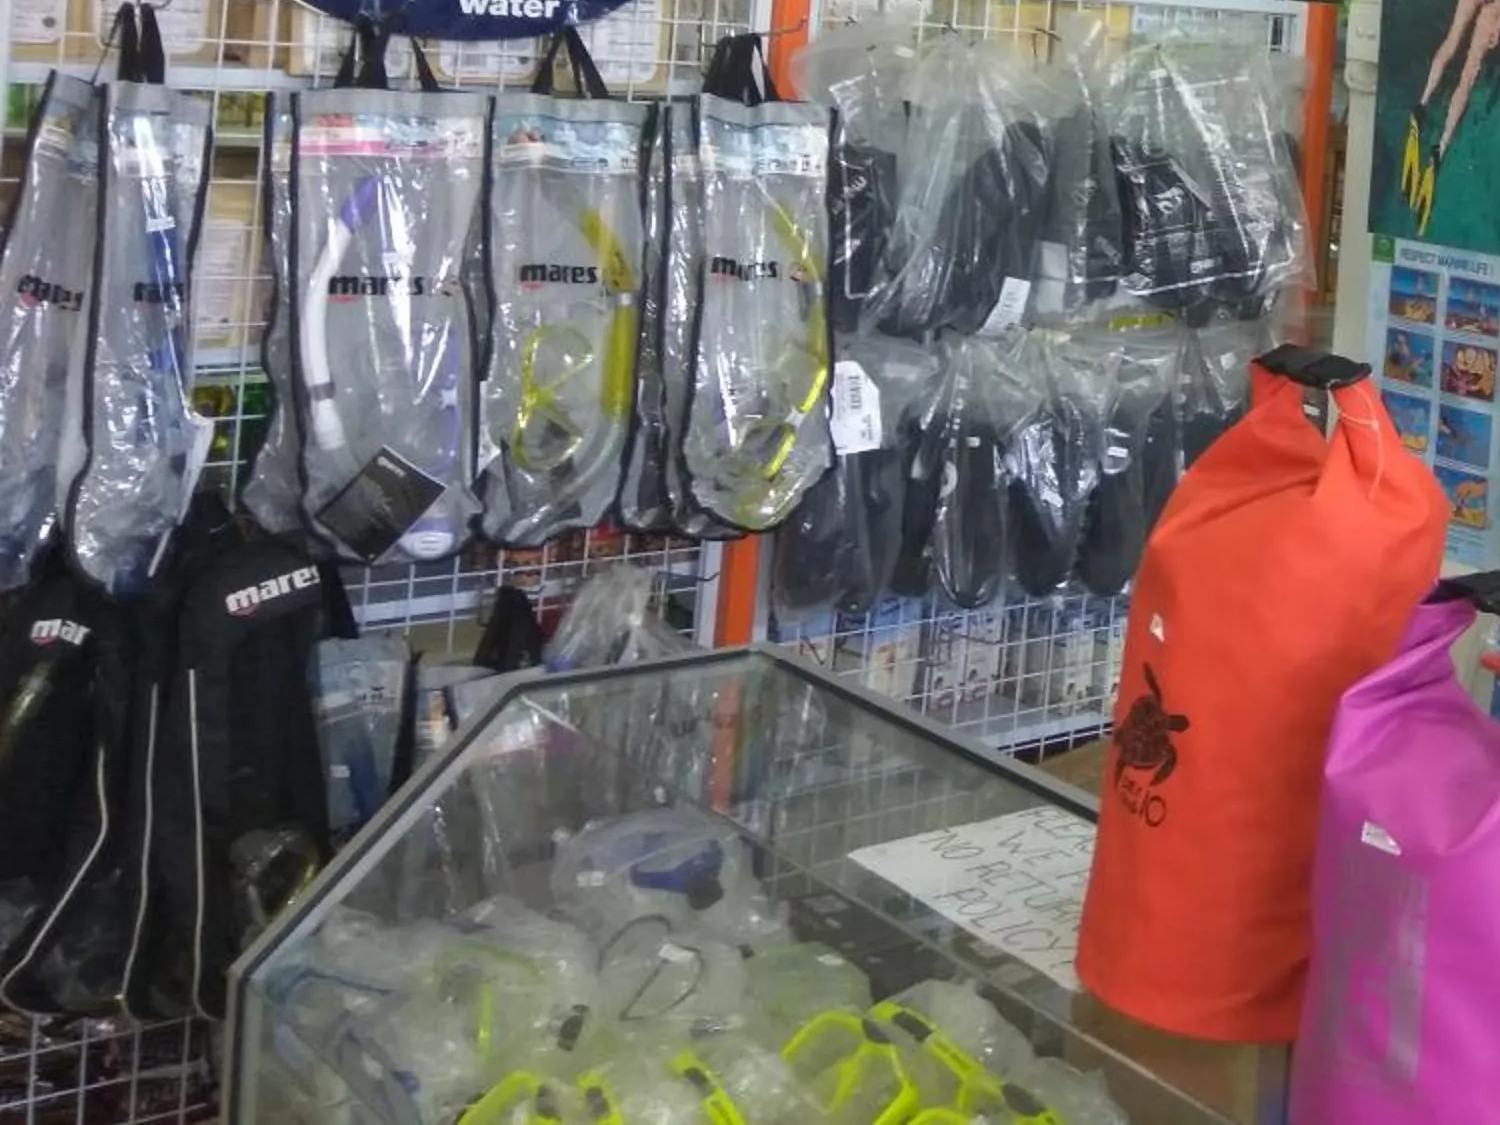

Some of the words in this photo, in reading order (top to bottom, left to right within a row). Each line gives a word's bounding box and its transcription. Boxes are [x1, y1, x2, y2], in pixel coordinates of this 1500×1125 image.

[520, 263, 598, 285] mares
[711, 256, 778, 282] mrs
[329, 276, 423, 297] mars
[30, 617, 92, 647] mar
